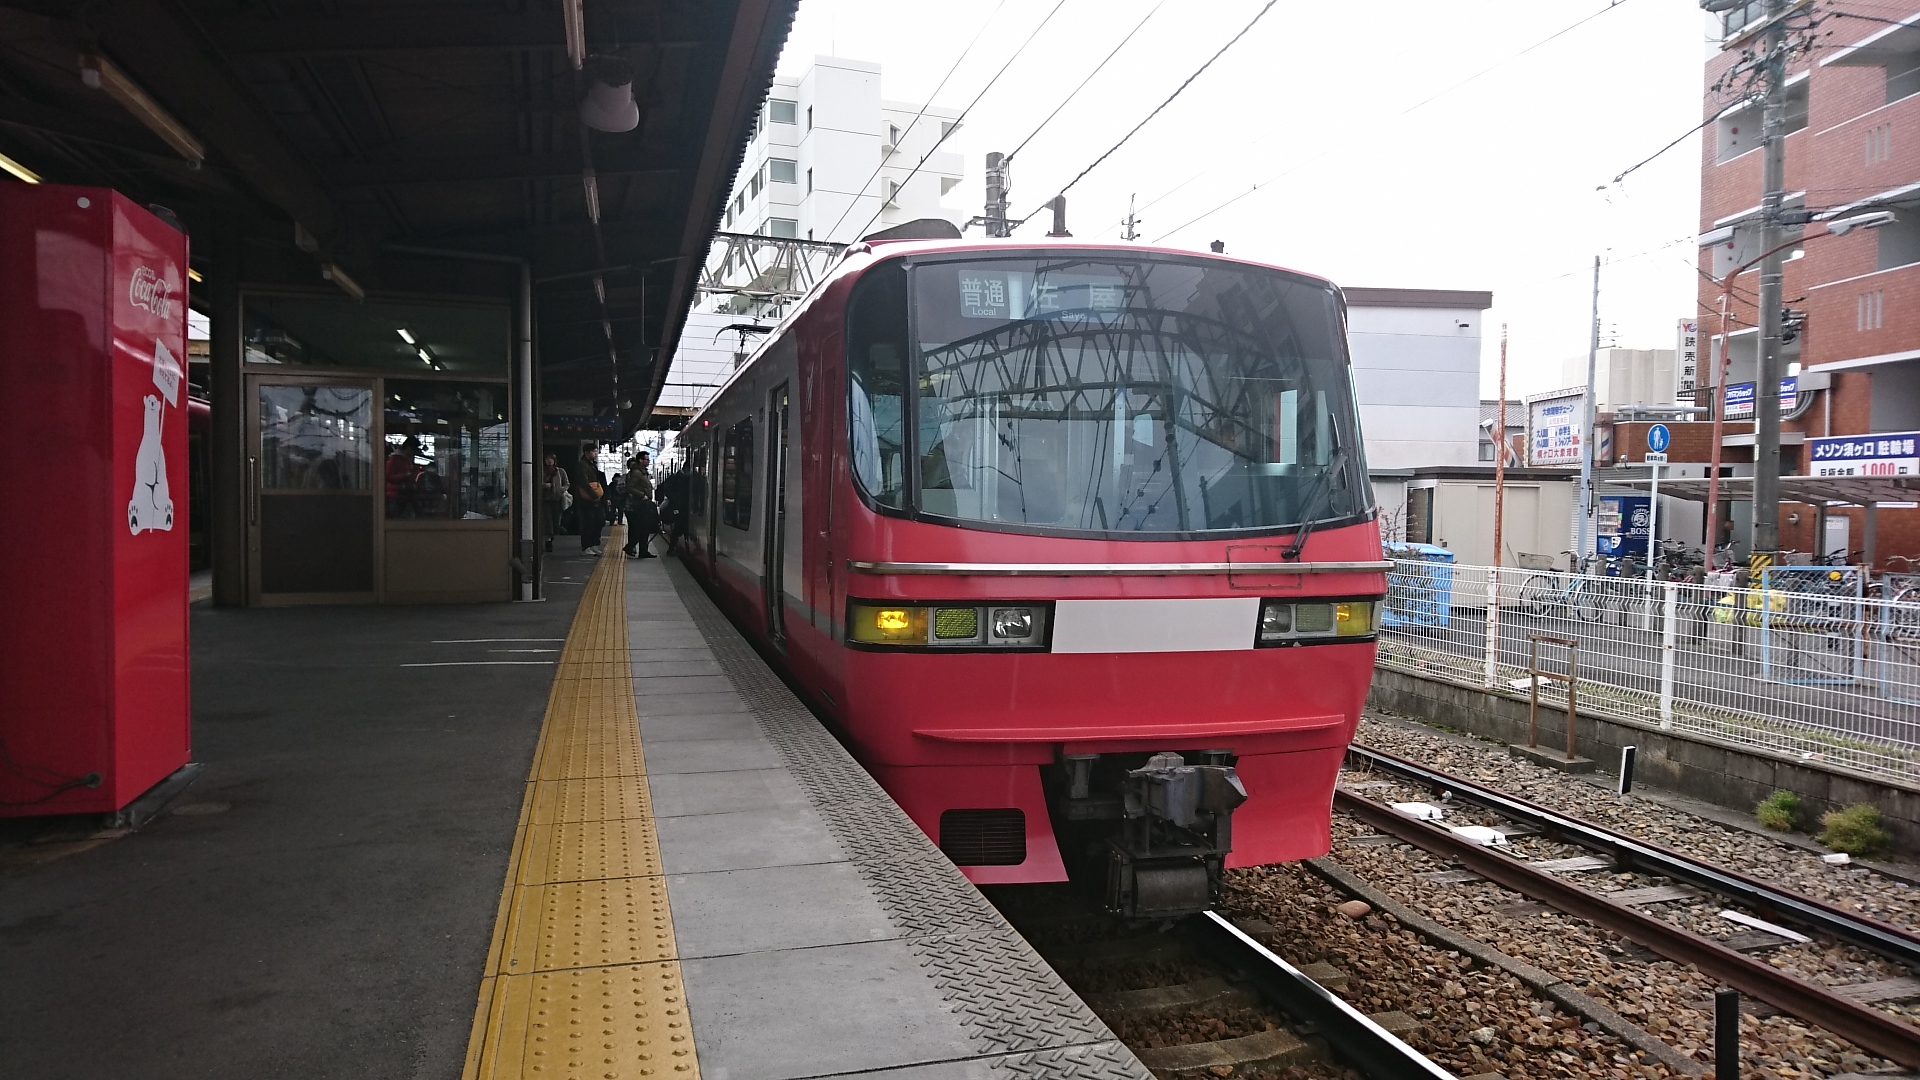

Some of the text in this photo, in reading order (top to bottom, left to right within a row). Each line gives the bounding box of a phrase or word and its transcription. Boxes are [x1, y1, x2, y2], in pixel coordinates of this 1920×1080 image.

[962, 278, 1005, 308] 普通
[972, 307, 997, 317] Local
[1684, 337, 1696, 391] 読売新聞
[1877, 438, 1915, 456] 駐輪場
[1630, 527, 1650, 535] BOSS
